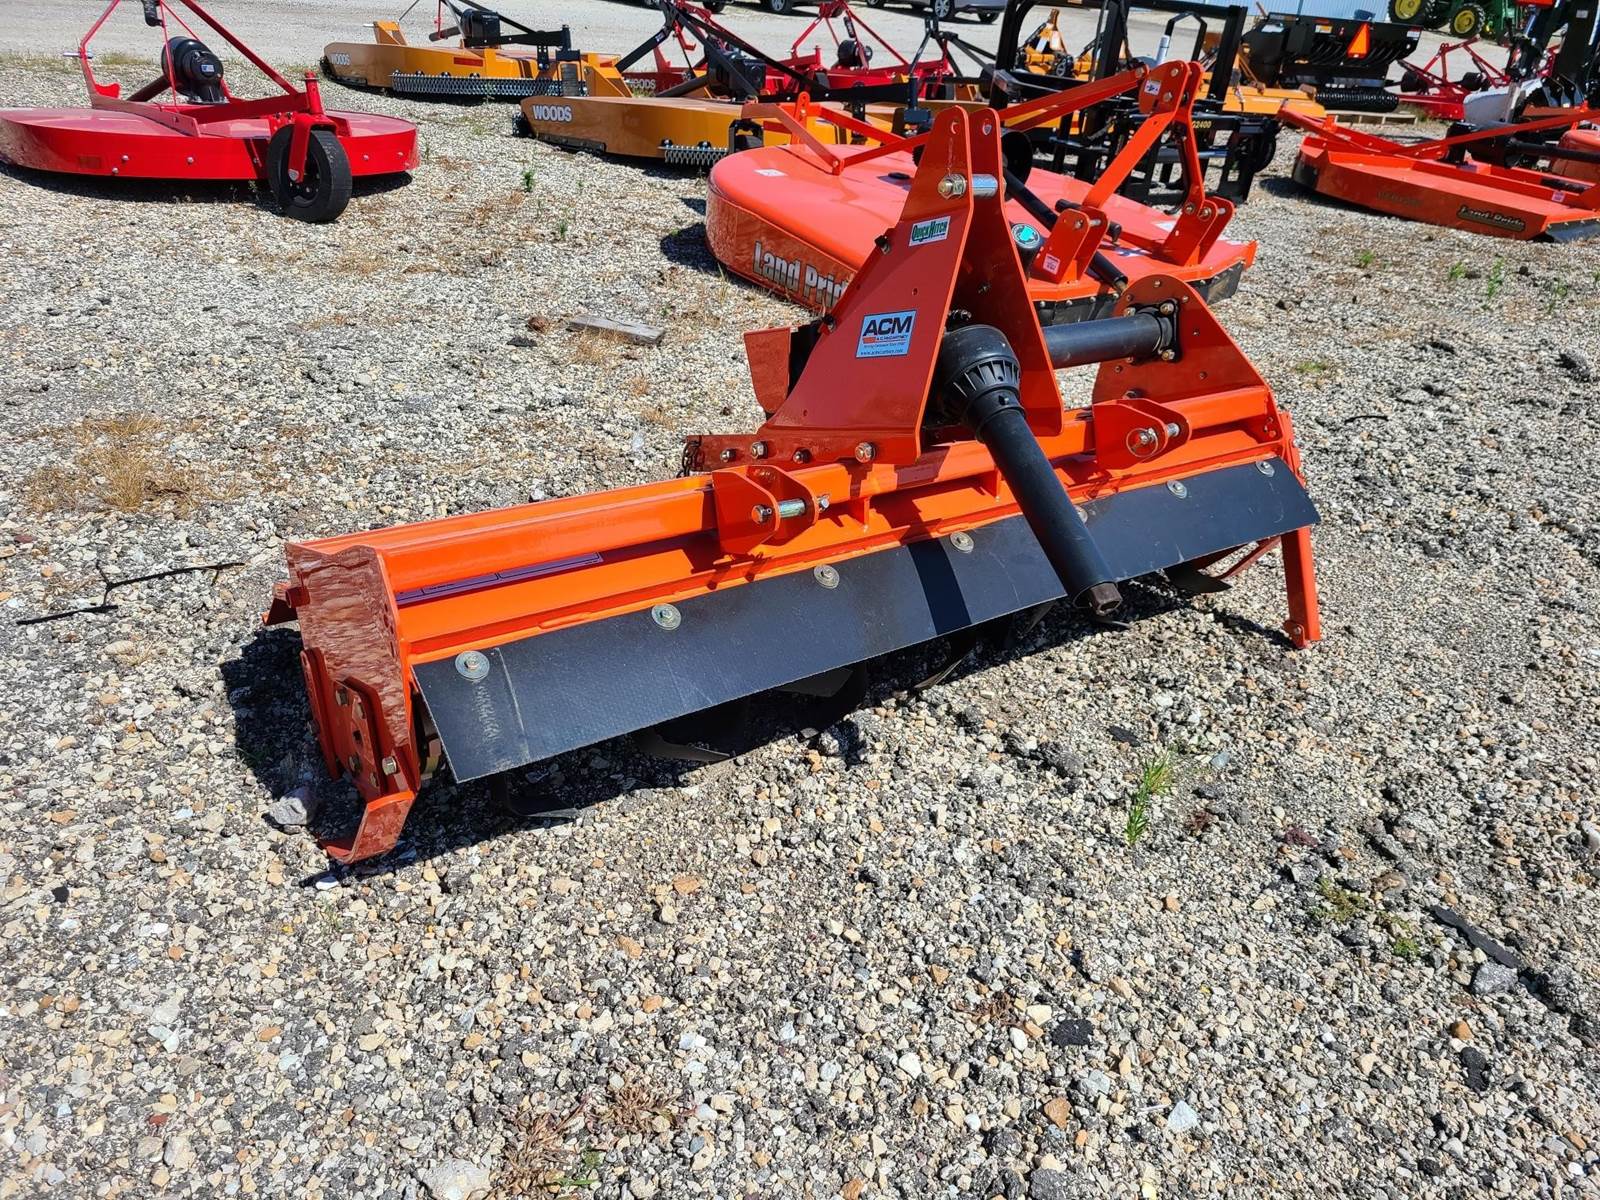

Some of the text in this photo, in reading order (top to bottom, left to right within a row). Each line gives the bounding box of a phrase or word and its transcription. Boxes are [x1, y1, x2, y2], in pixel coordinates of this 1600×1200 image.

[532, 104, 573, 122] WOODS
[753, 241, 800, 293] Land
[863, 316, 912, 336] ACM
